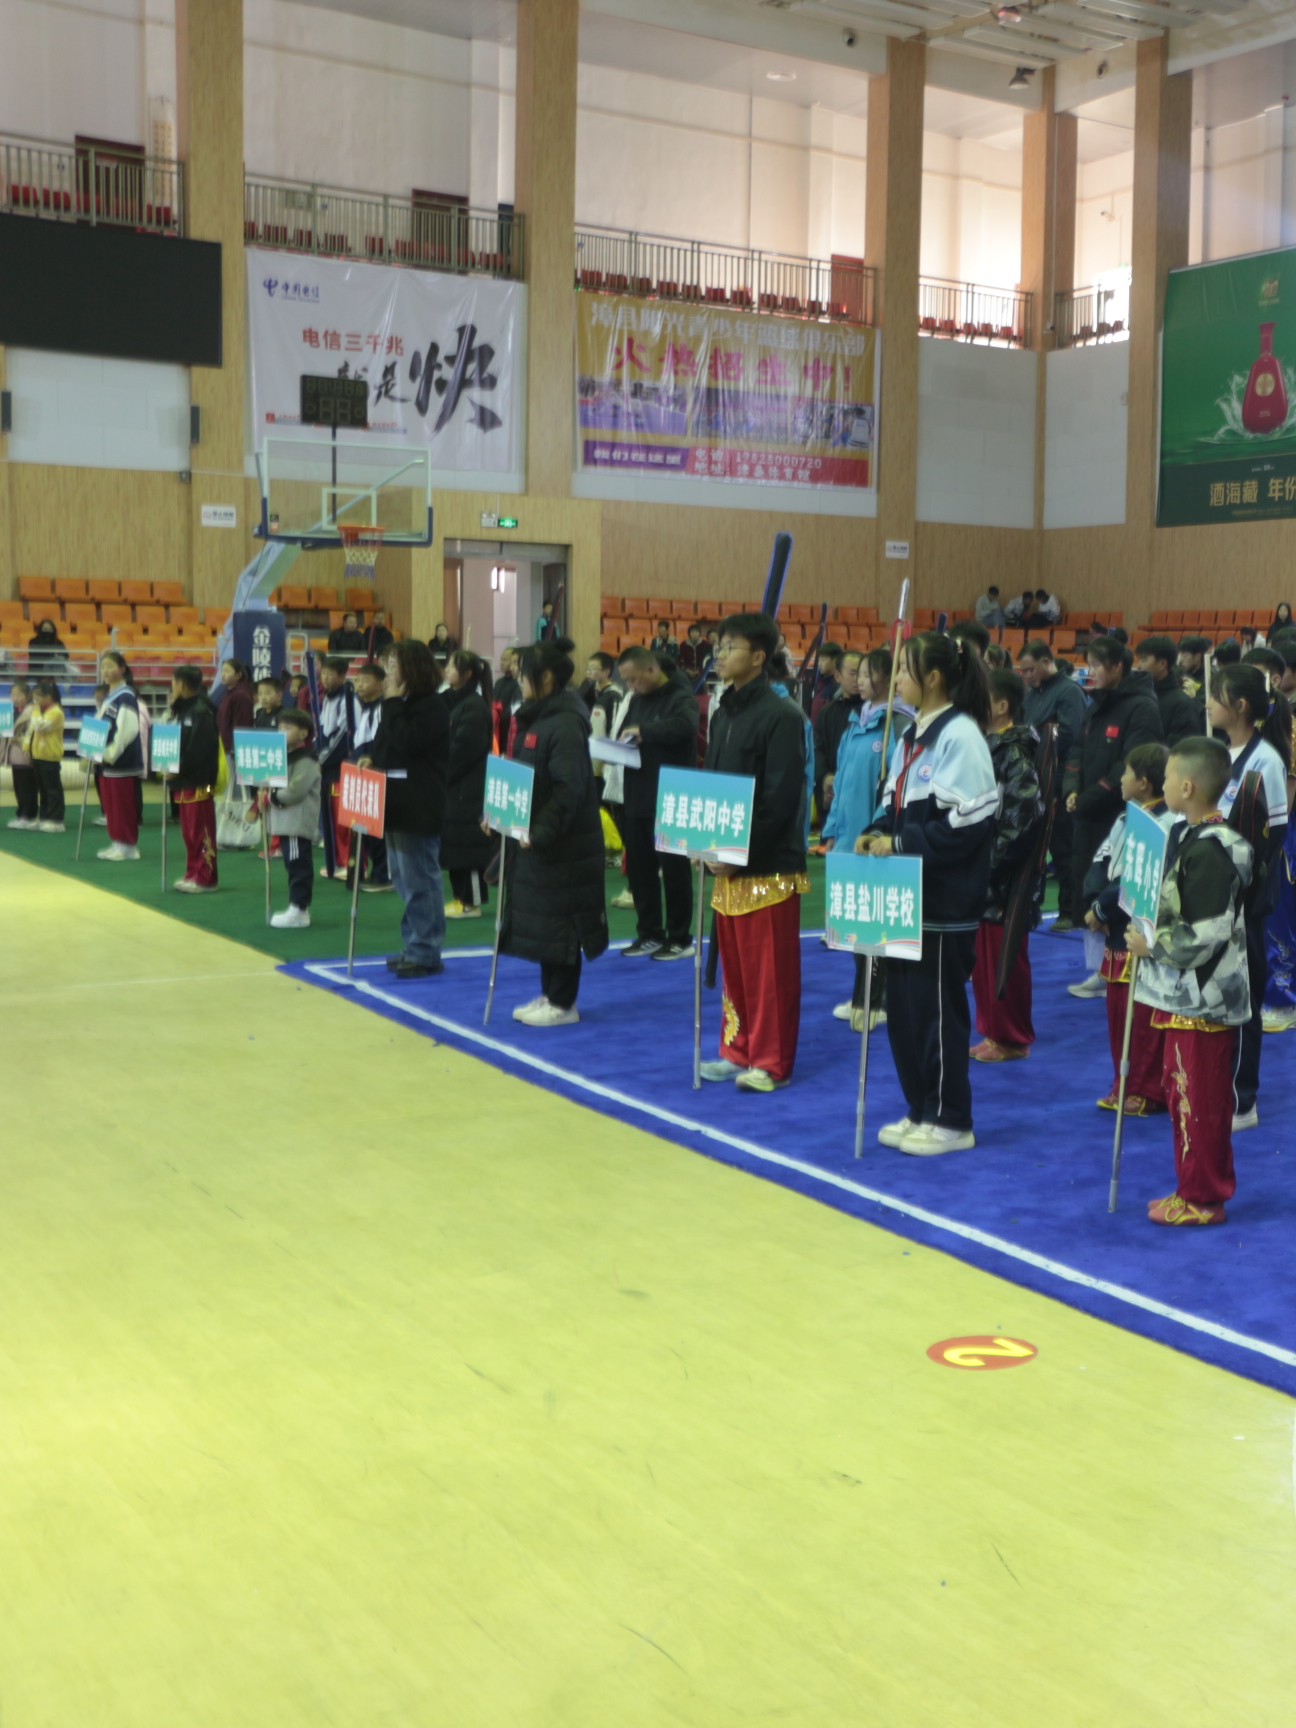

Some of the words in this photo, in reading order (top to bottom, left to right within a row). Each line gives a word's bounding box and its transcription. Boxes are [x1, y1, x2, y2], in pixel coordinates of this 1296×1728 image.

[302, 327, 405, 356] 电信三千兆
[408, 323, 503, 440] 快
[1209, 480, 1259, 507] 酒海藏
[237, 746, 283, 770] 漳县第二中学
[660, 794, 745, 838] 漳县武阳中学
[830, 882, 915, 928] 漳县盐川学校
